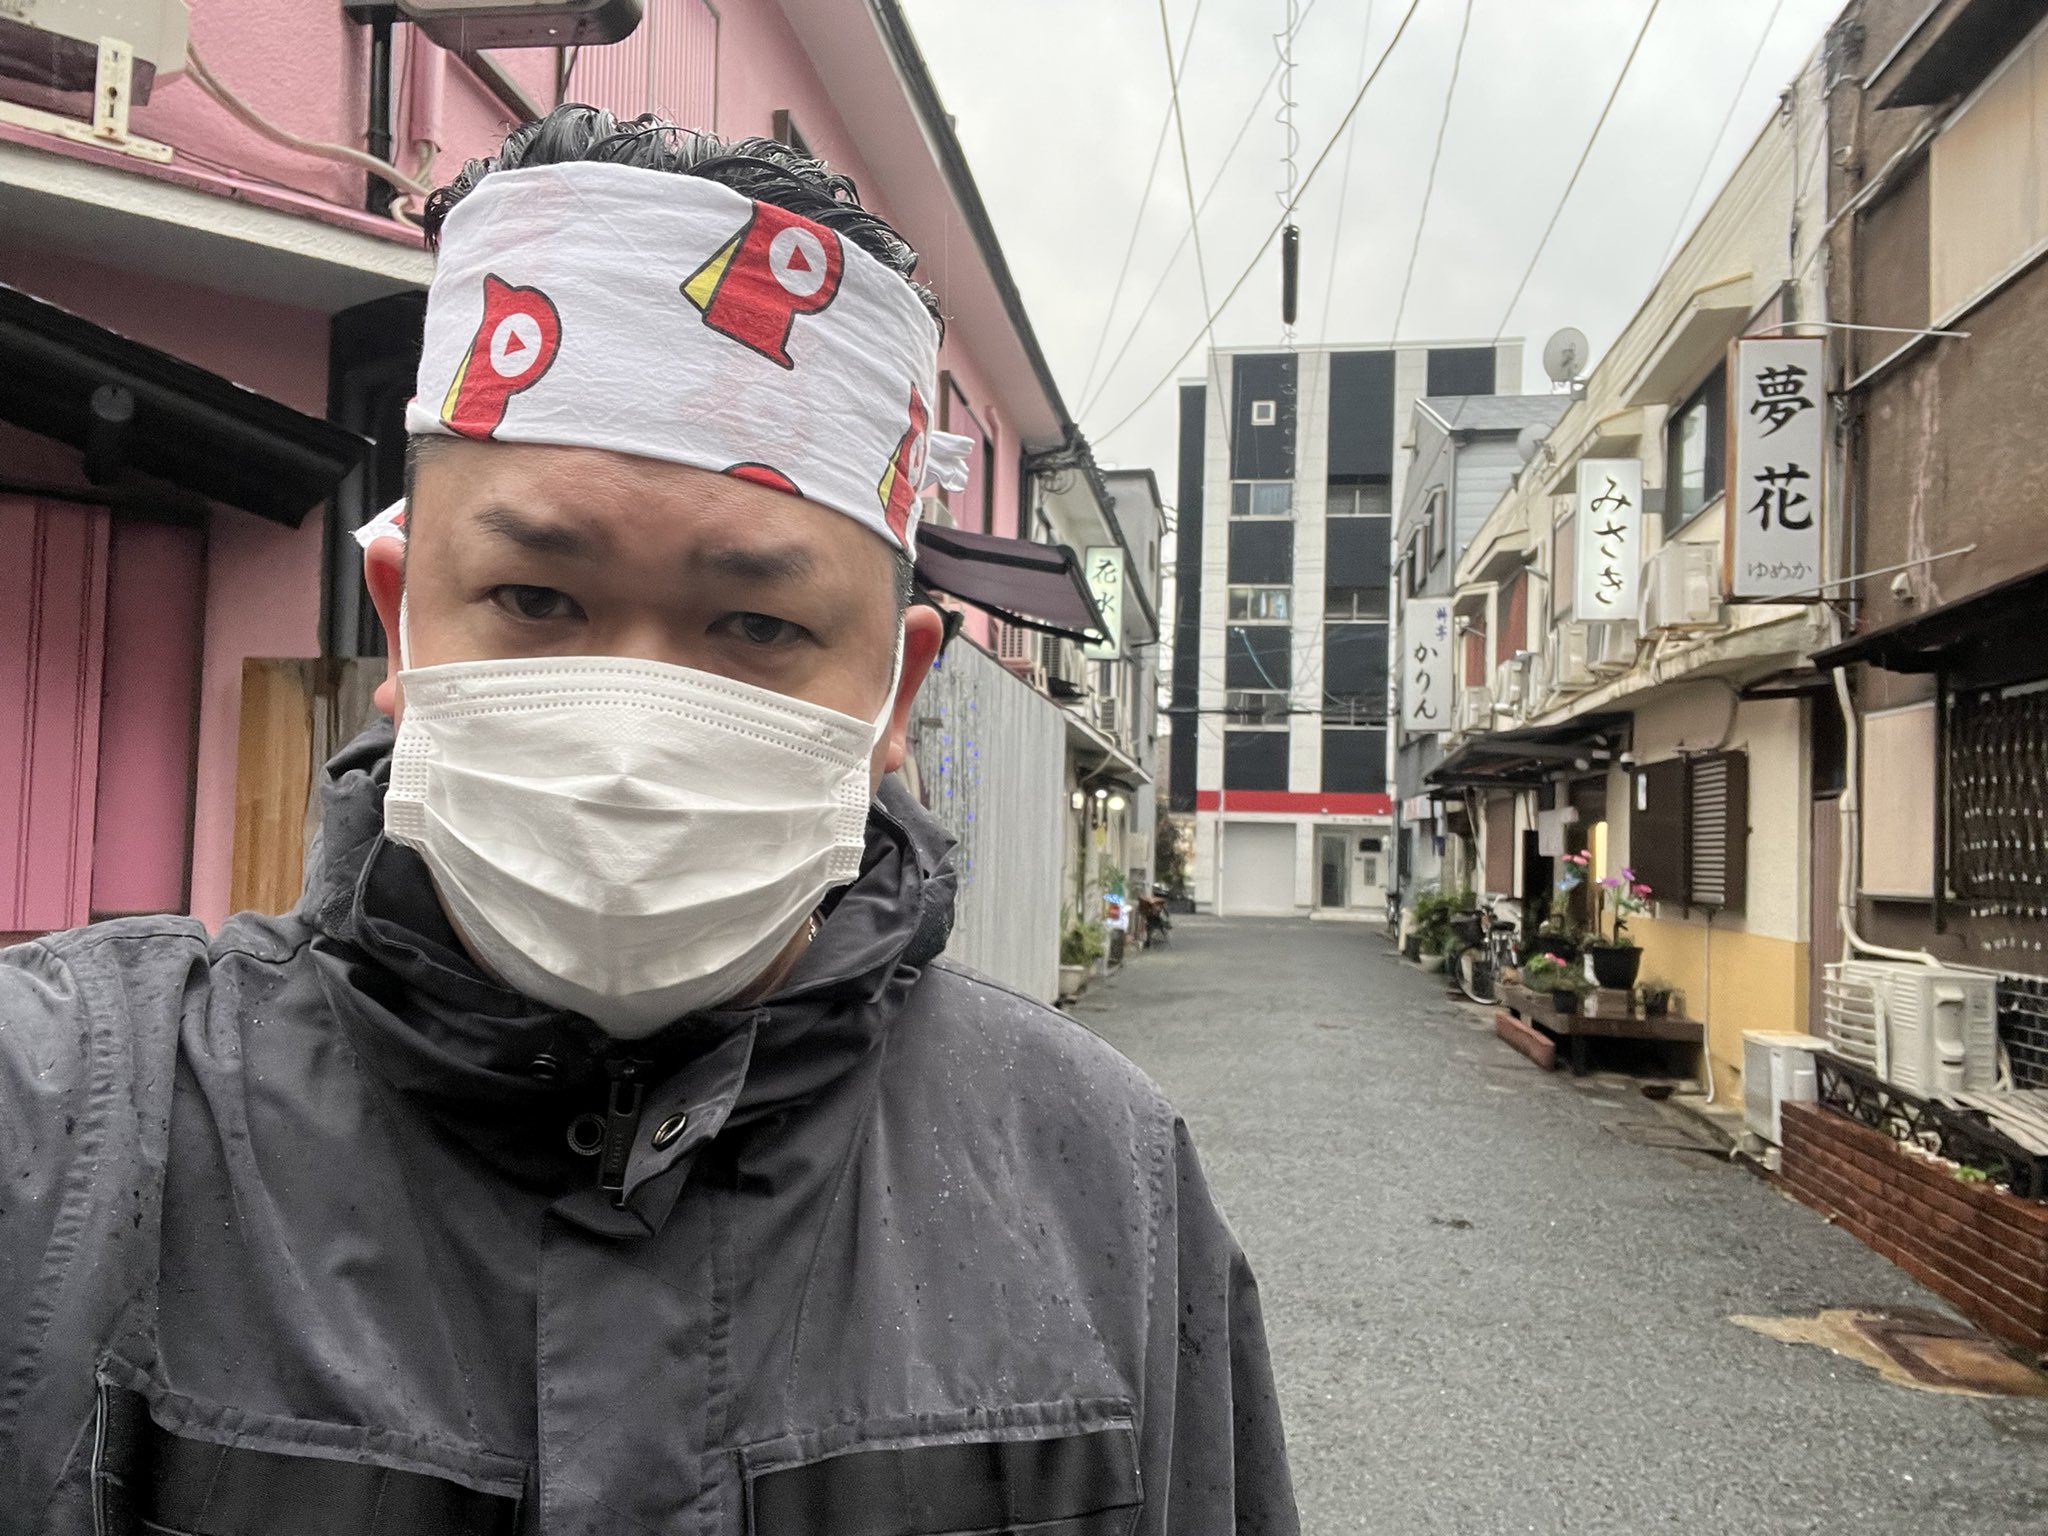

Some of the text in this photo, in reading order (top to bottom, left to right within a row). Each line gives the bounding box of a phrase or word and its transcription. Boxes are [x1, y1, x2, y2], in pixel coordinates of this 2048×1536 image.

[1748, 364, 1815, 531] 夢花
[1591, 476, 1632, 604] みさき
[1748, 561, 1812, 579] ゆめか
[1414, 641, 1438, 719] かりん
